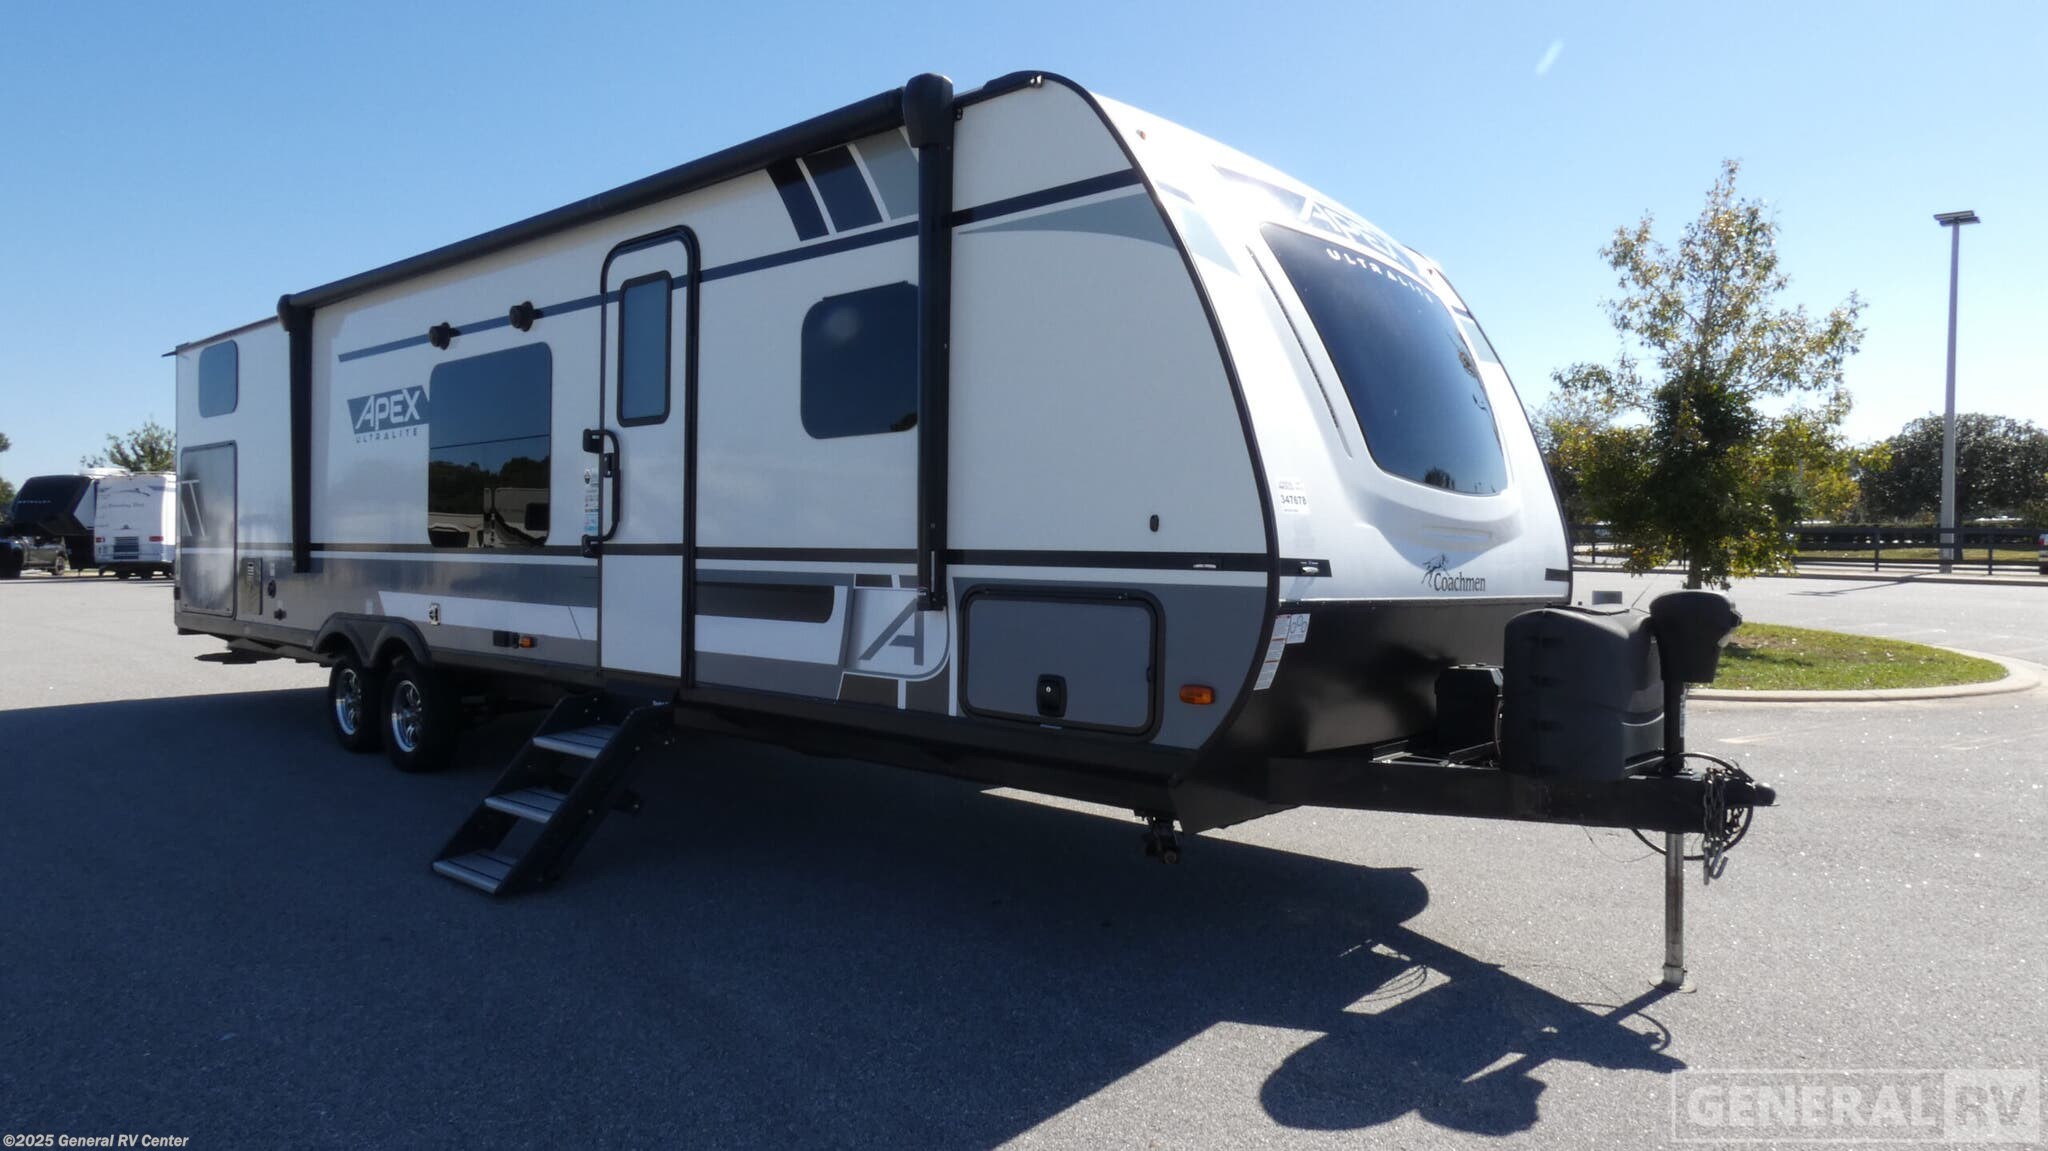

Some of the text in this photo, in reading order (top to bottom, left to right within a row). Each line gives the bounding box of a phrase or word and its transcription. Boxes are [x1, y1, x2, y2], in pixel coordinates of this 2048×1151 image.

[354, 388, 421, 431] APEX
[355, 427, 418, 444] ULTRALITE
[1434, 571, 1486, 592] Coachmen
